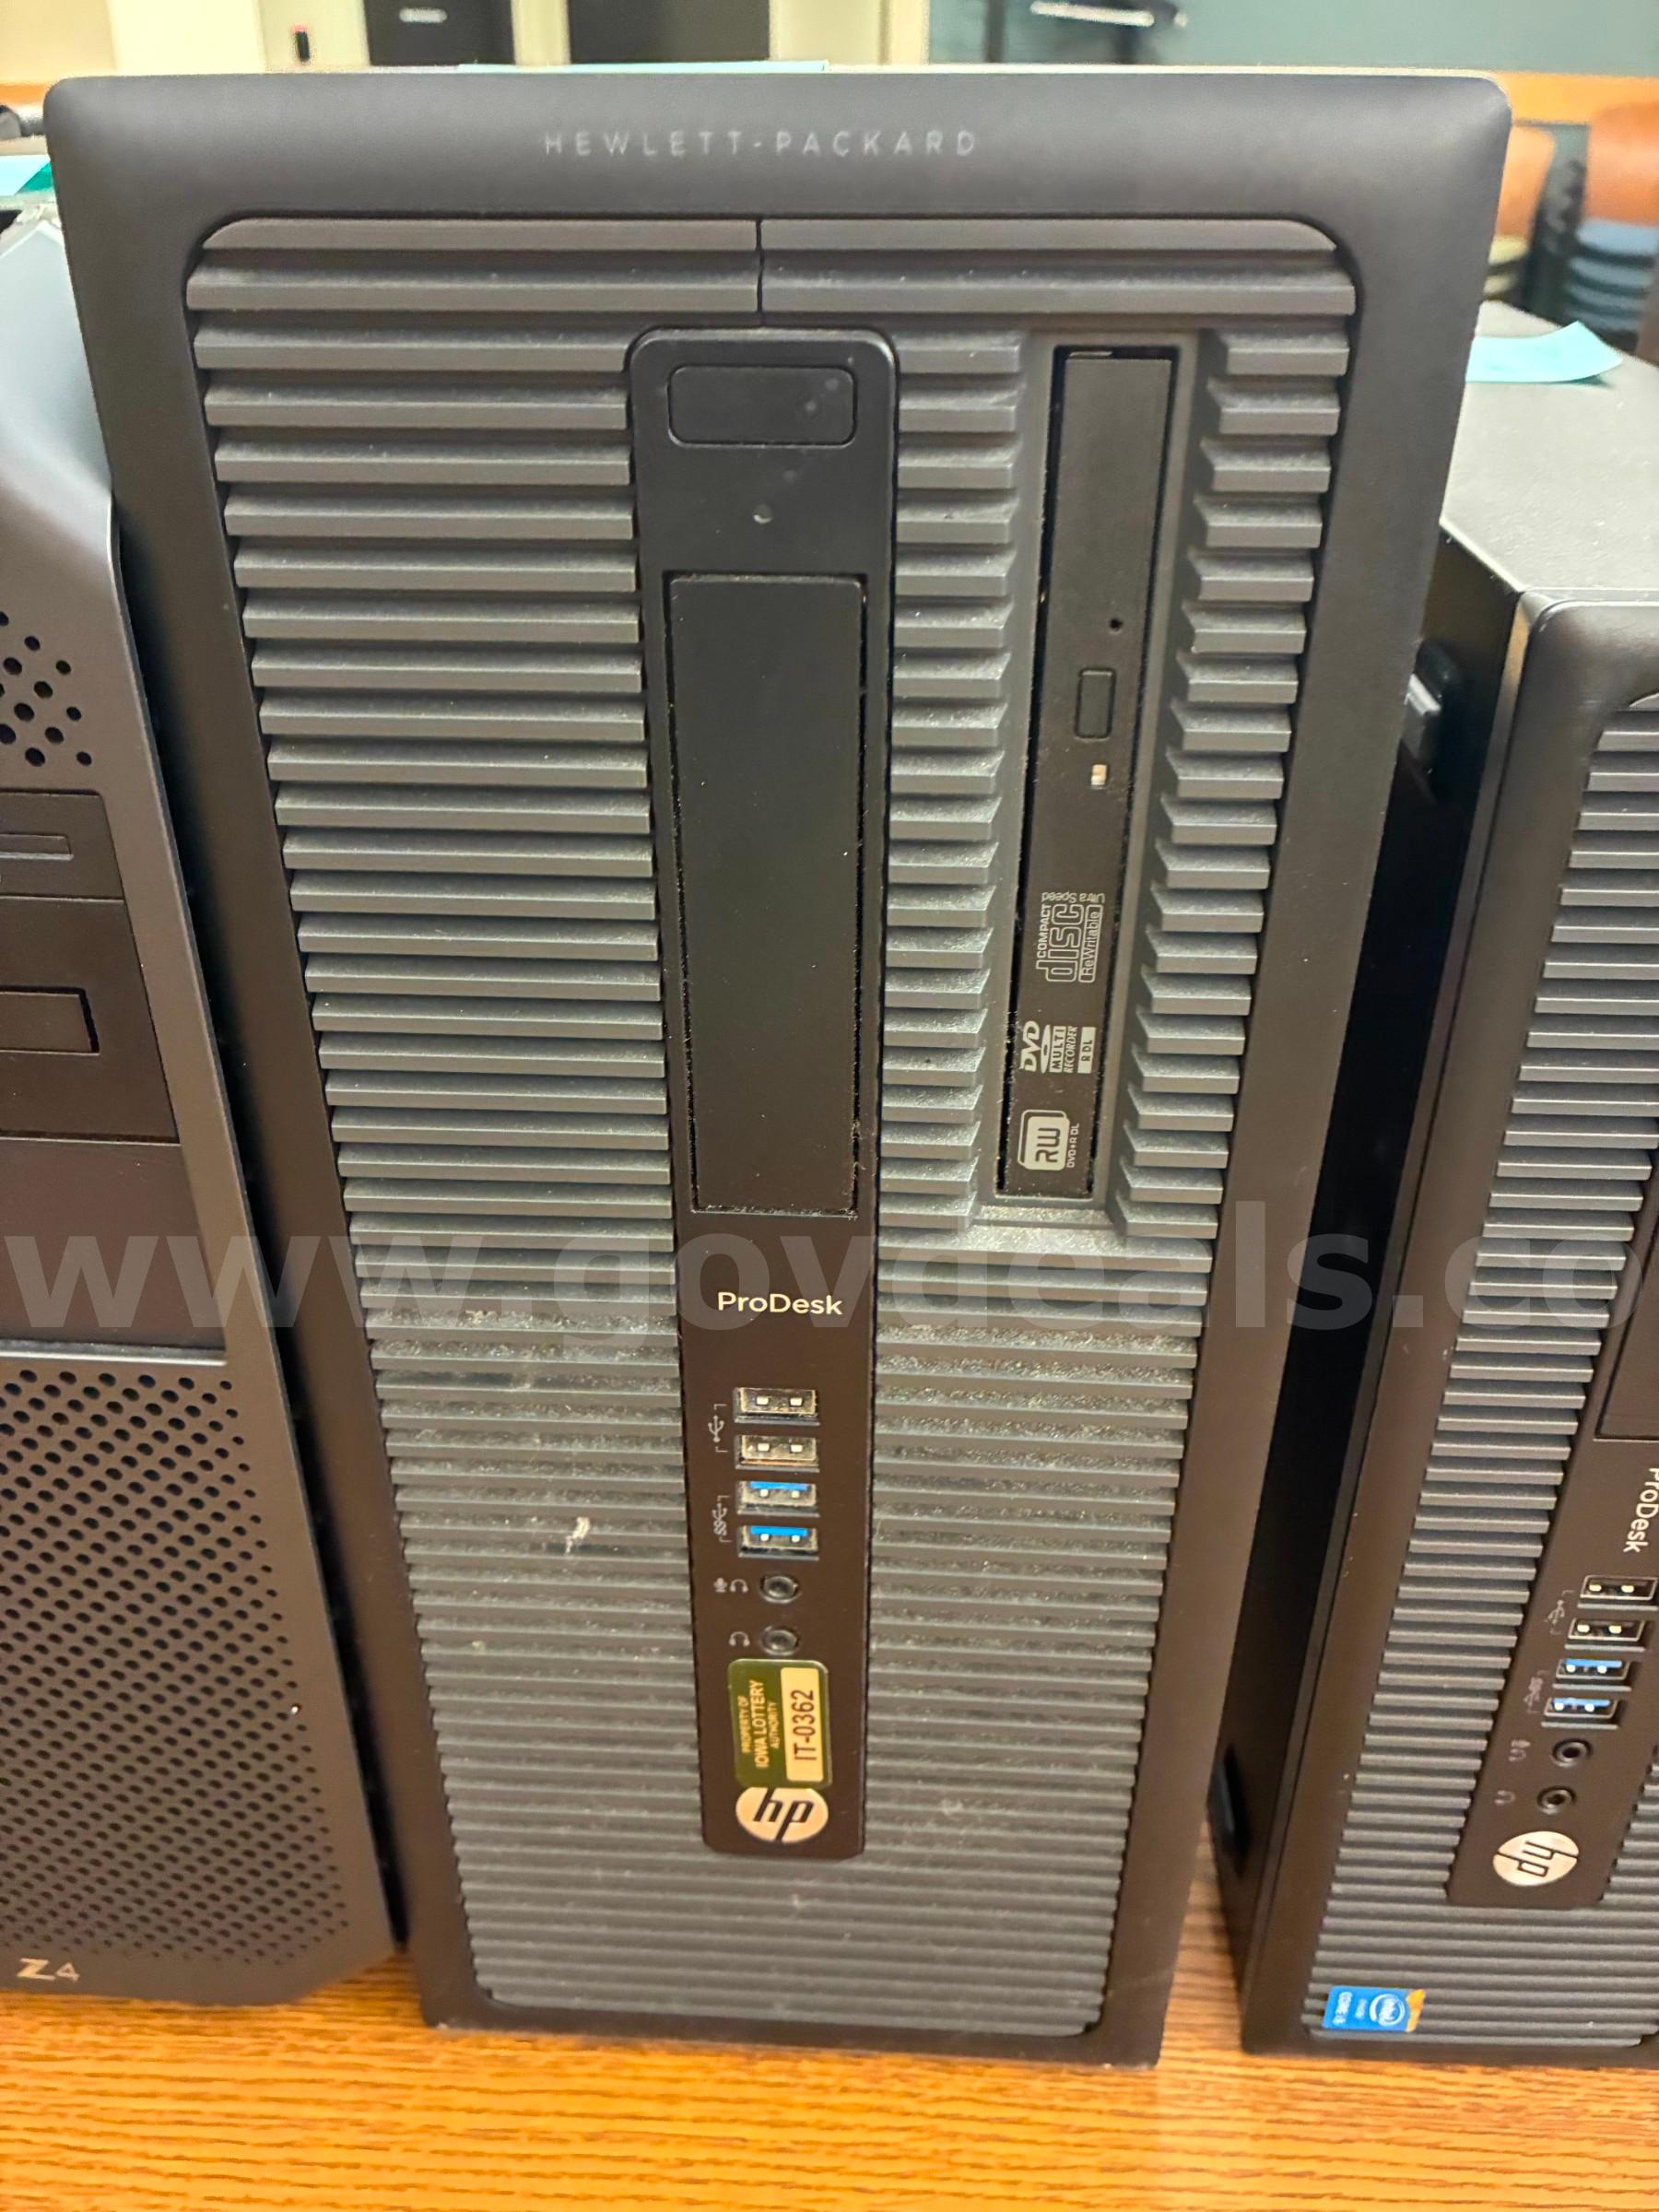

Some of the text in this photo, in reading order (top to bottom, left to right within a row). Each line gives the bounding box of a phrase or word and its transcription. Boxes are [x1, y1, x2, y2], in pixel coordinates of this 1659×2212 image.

[543, 129, 975, 158] HEWLETT-PACKARD
[1041, 890, 1077, 904] Speed
[1036, 903, 1052, 959] COMPACT
[1081, 911, 1101, 976] ReWritable
[1018, 1020, 1041, 1072] DVD
[1052, 1029, 1065, 1070] MULTI
[1063, 1025, 1078, 1074] RECORDER
[1034, 1127, 1061, 1163] RW
[717, 1291, 843, 1315] ProDesk
[736, 1695, 751, 1754] PROPERTY OF
[748, 1679, 770, 1768] IOWA LOTTERY
[767, 1700, 781, 1749] AUTHORITY
[790, 1689, 818, 1761] IT-0362
[752, 1787, 815, 1842] hp
[1497, 1840, 1579, 1877] hp
[17, 1958, 80, 1982] Z4
